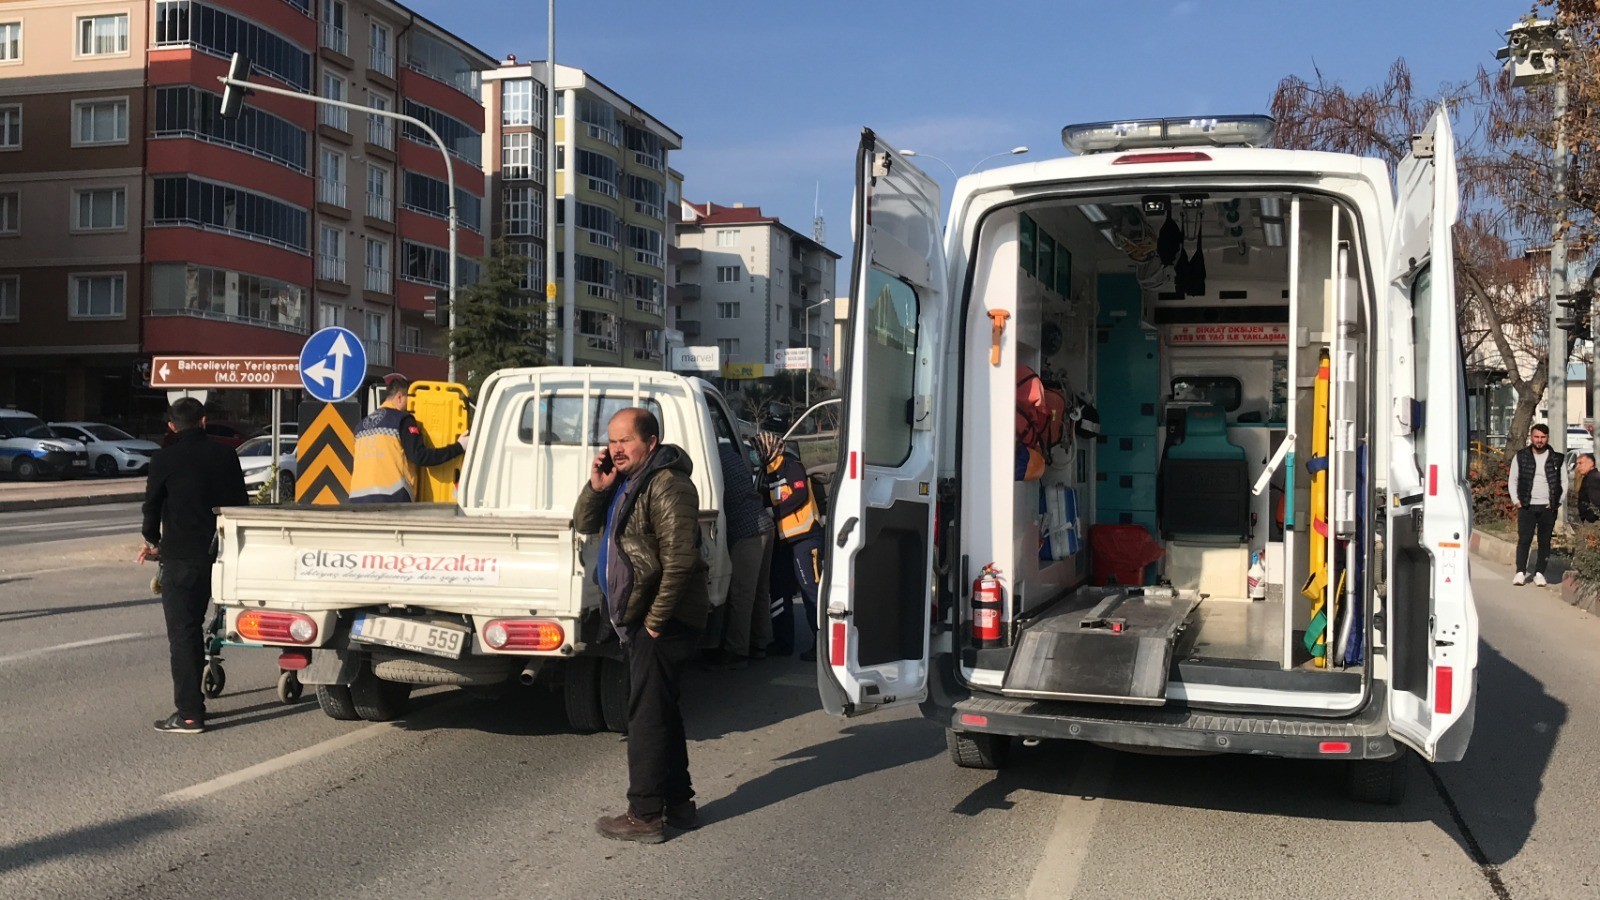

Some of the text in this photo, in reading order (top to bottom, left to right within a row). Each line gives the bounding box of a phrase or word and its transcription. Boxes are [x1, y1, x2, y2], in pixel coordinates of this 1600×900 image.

[681, 352, 714, 363] marvel
[178, 360, 299, 373] Bahçelievler Yerleşmes
[215, 371, 275, 383] (M.Ö. 7000)
[301, 550, 358, 570] eltaş
[367, 617, 387, 637] 11
[395, 622, 418, 643] AJ
[427, 627, 460, 651] 559
